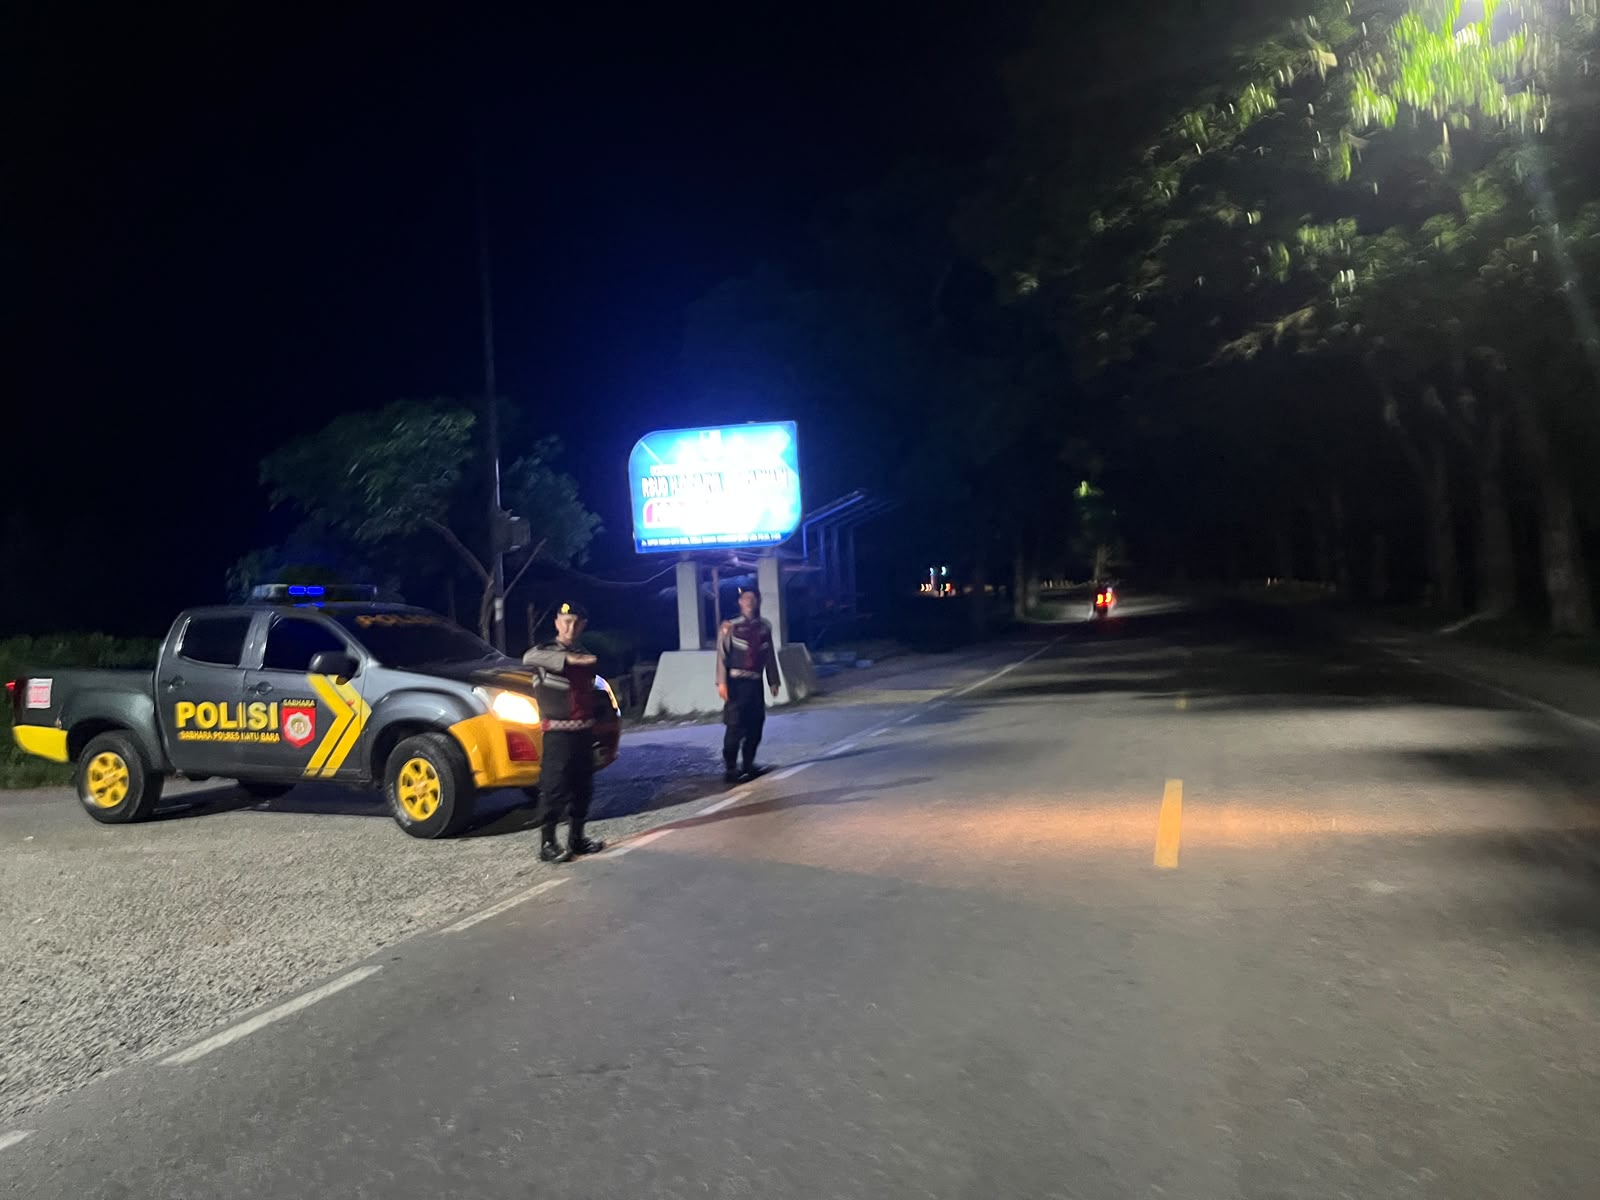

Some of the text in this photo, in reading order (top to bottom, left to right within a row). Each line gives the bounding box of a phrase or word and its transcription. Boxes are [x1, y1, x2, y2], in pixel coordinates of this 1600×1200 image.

[283, 698, 315, 707] SABHARA
[177, 700, 278, 731] POLISI
[179, 731, 212, 742] SABHARA
[213, 731, 240, 742] POLRES
[260, 732, 281, 743] BARA
